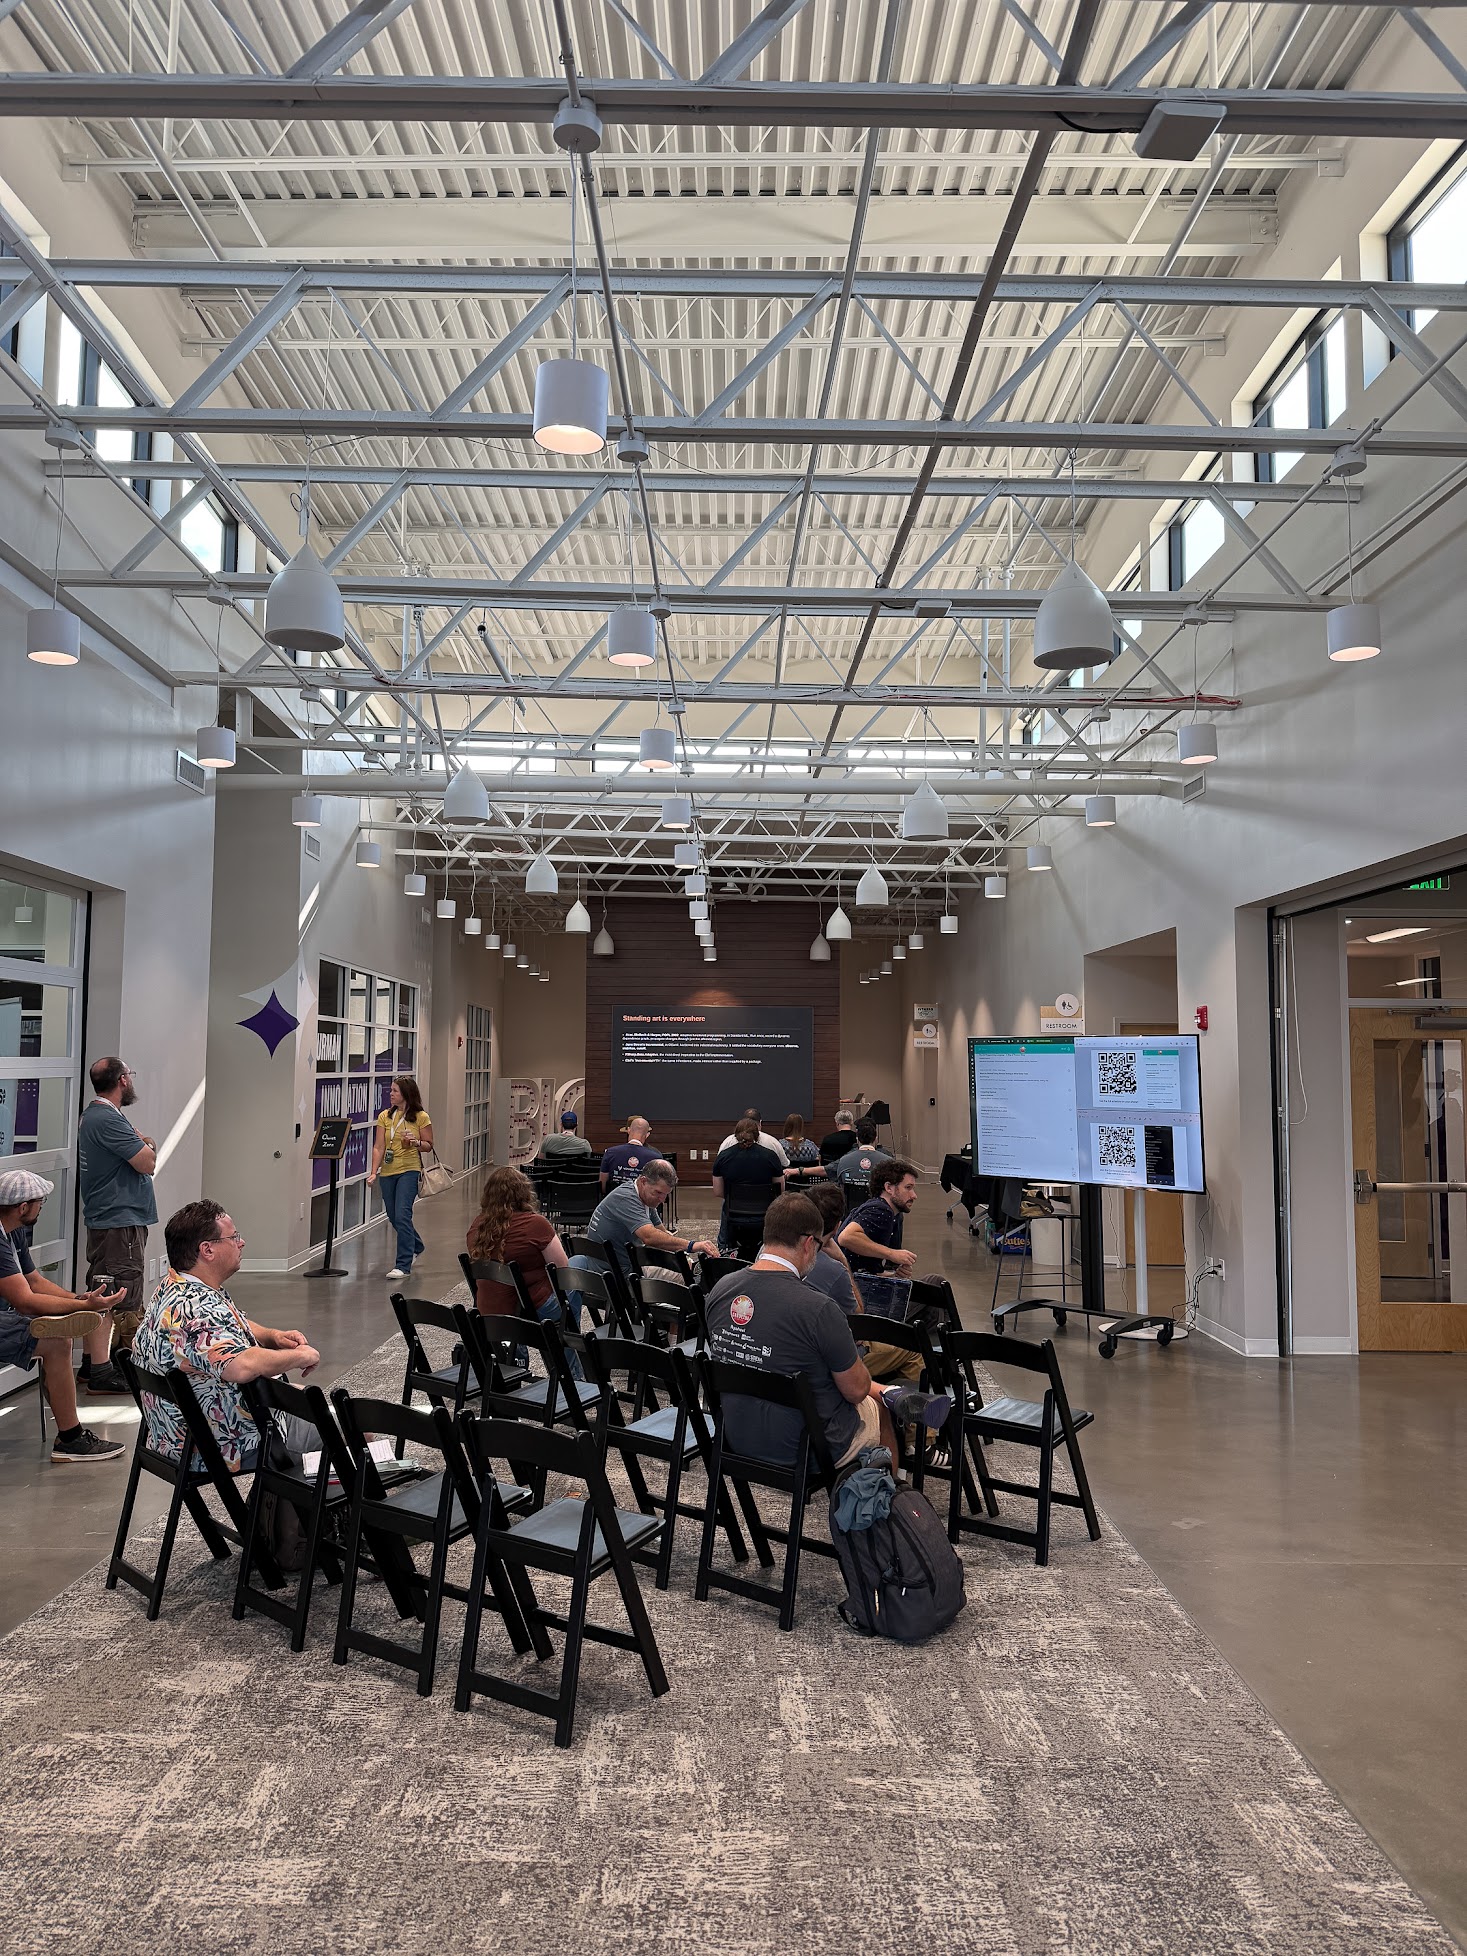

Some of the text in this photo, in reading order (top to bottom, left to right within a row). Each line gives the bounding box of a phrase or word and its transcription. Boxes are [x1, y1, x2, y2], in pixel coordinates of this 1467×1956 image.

[622, 1015, 651, 1023] Standing
[669, 1015, 706, 1023] everywhere
[316, 1032, 342, 1061] URMAN
